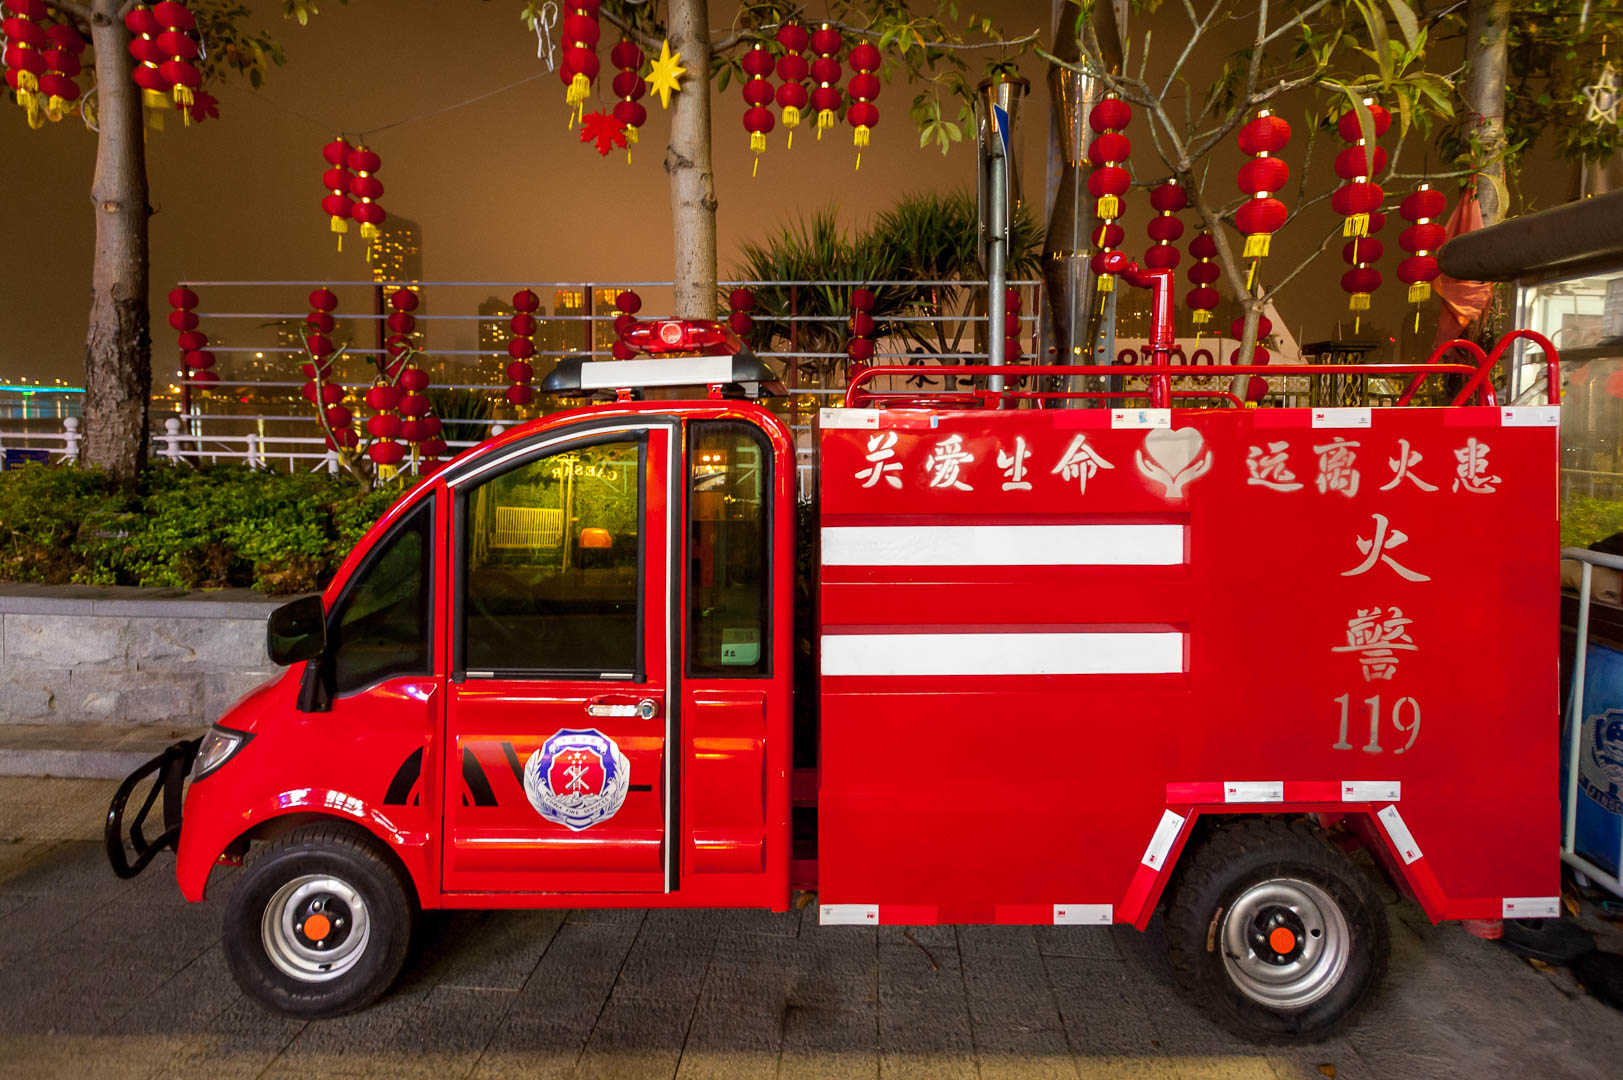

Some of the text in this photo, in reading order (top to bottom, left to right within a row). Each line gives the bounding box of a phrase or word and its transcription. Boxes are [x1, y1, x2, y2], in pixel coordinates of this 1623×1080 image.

[855, 431, 1502, 498] 关爱生命 远离火患
[1330, 513, 1432, 682] 火警
[1332, 693, 1421, 754] 119
[545, 797, 563, 810] CHINA
